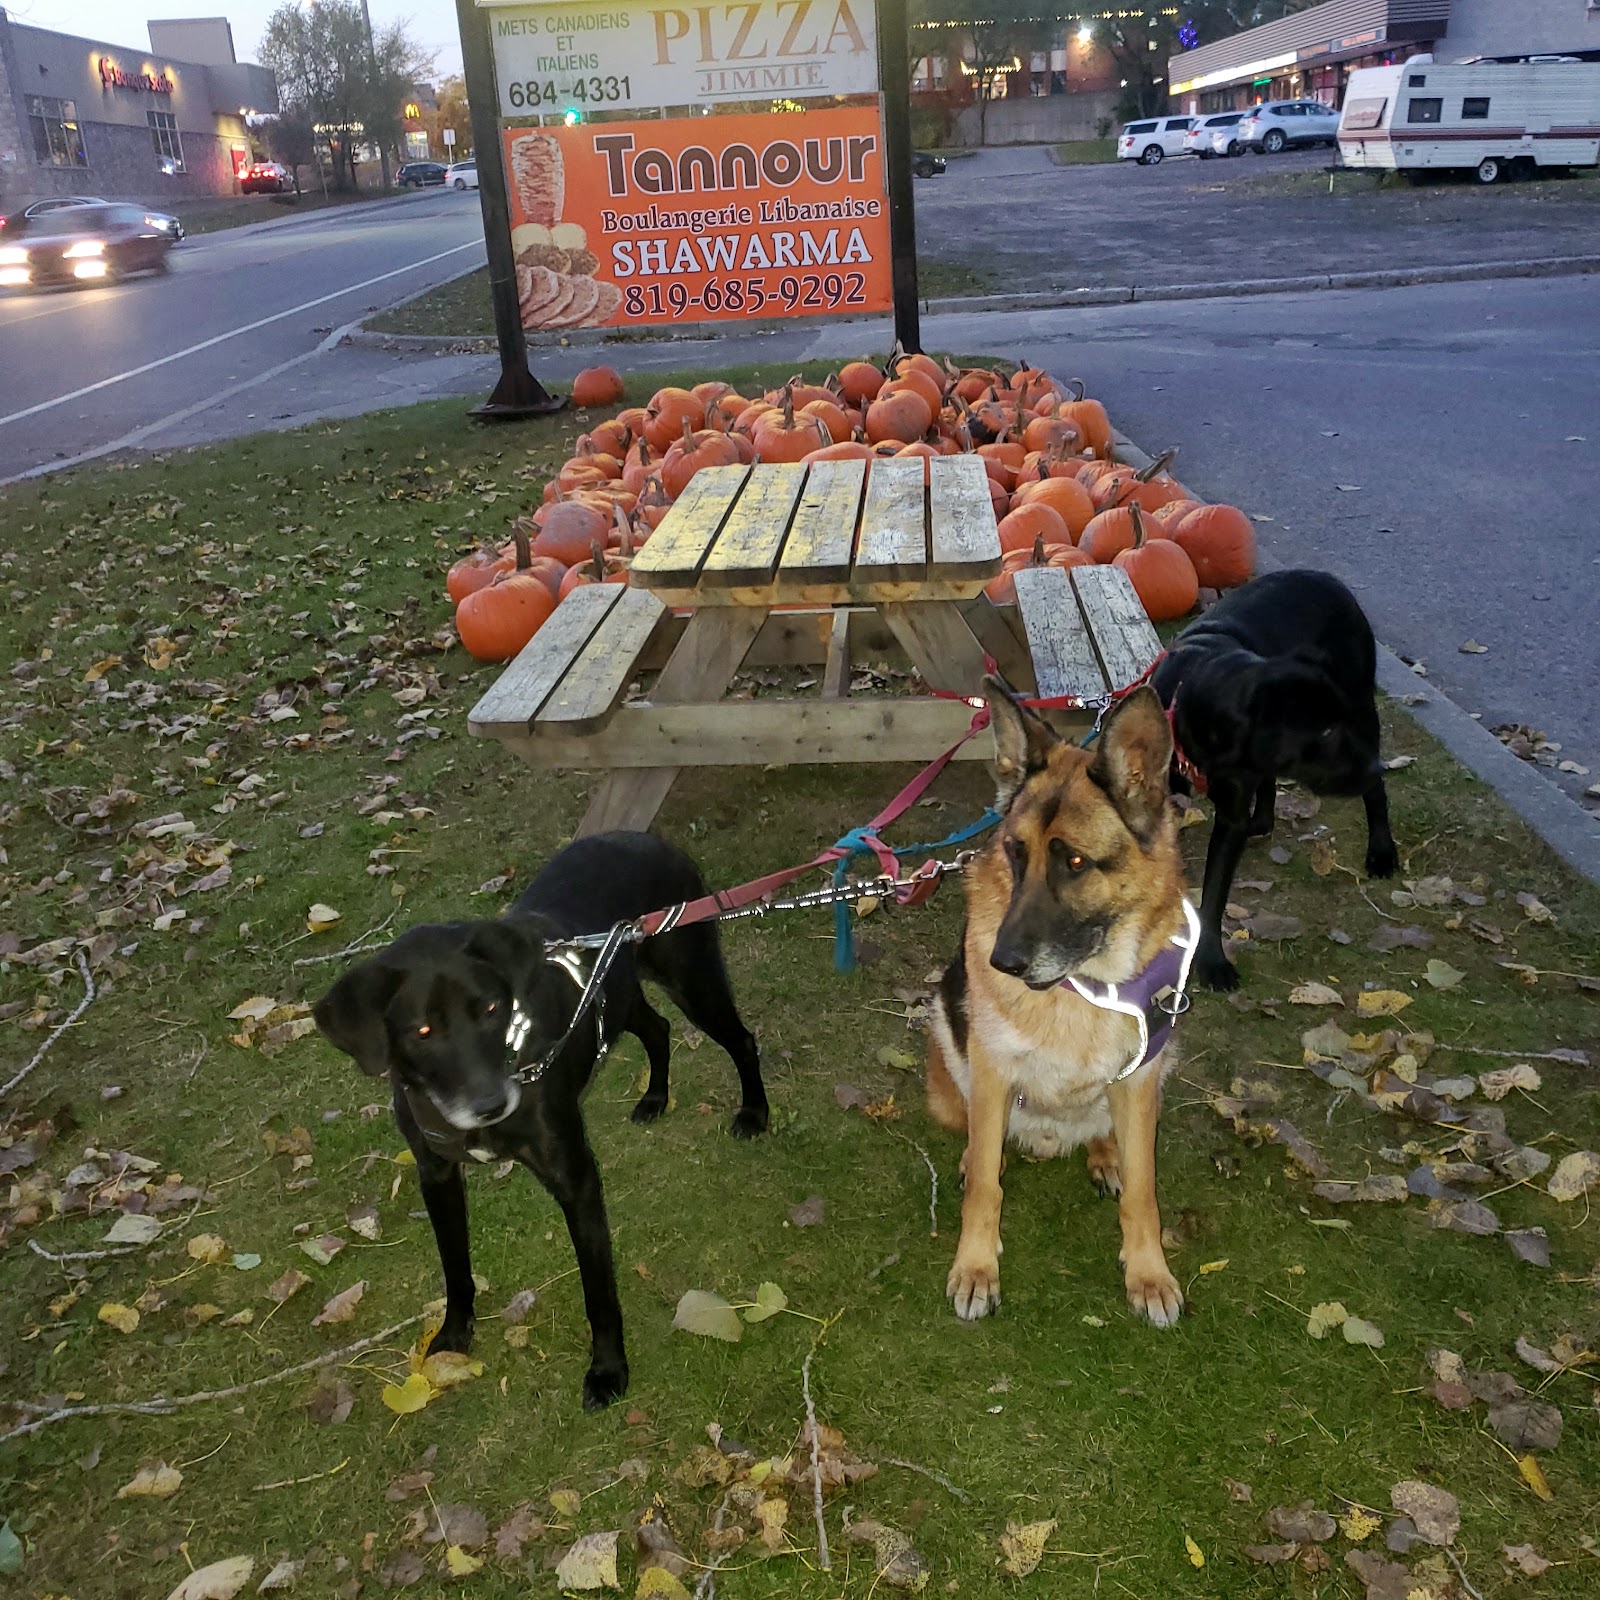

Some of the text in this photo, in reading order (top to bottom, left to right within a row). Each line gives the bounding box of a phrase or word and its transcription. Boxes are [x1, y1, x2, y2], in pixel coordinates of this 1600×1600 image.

[498, 12, 630, 36] METS CANADIENS
[648, 0, 869, 65] PIZZA
[556, 35, 574, 51] ET
[537, 53, 599, 72] ITALIENS
[701, 65, 823, 92] JIMMIE
[509, 75, 631, 108] 684-4331
[593, 133, 876, 197] Tannour
[601, 195, 880, 233] Boulangerie Libanaise
[612, 227, 873, 277] SHAWARMA
[624, 272, 866, 317] 819-685-9292
